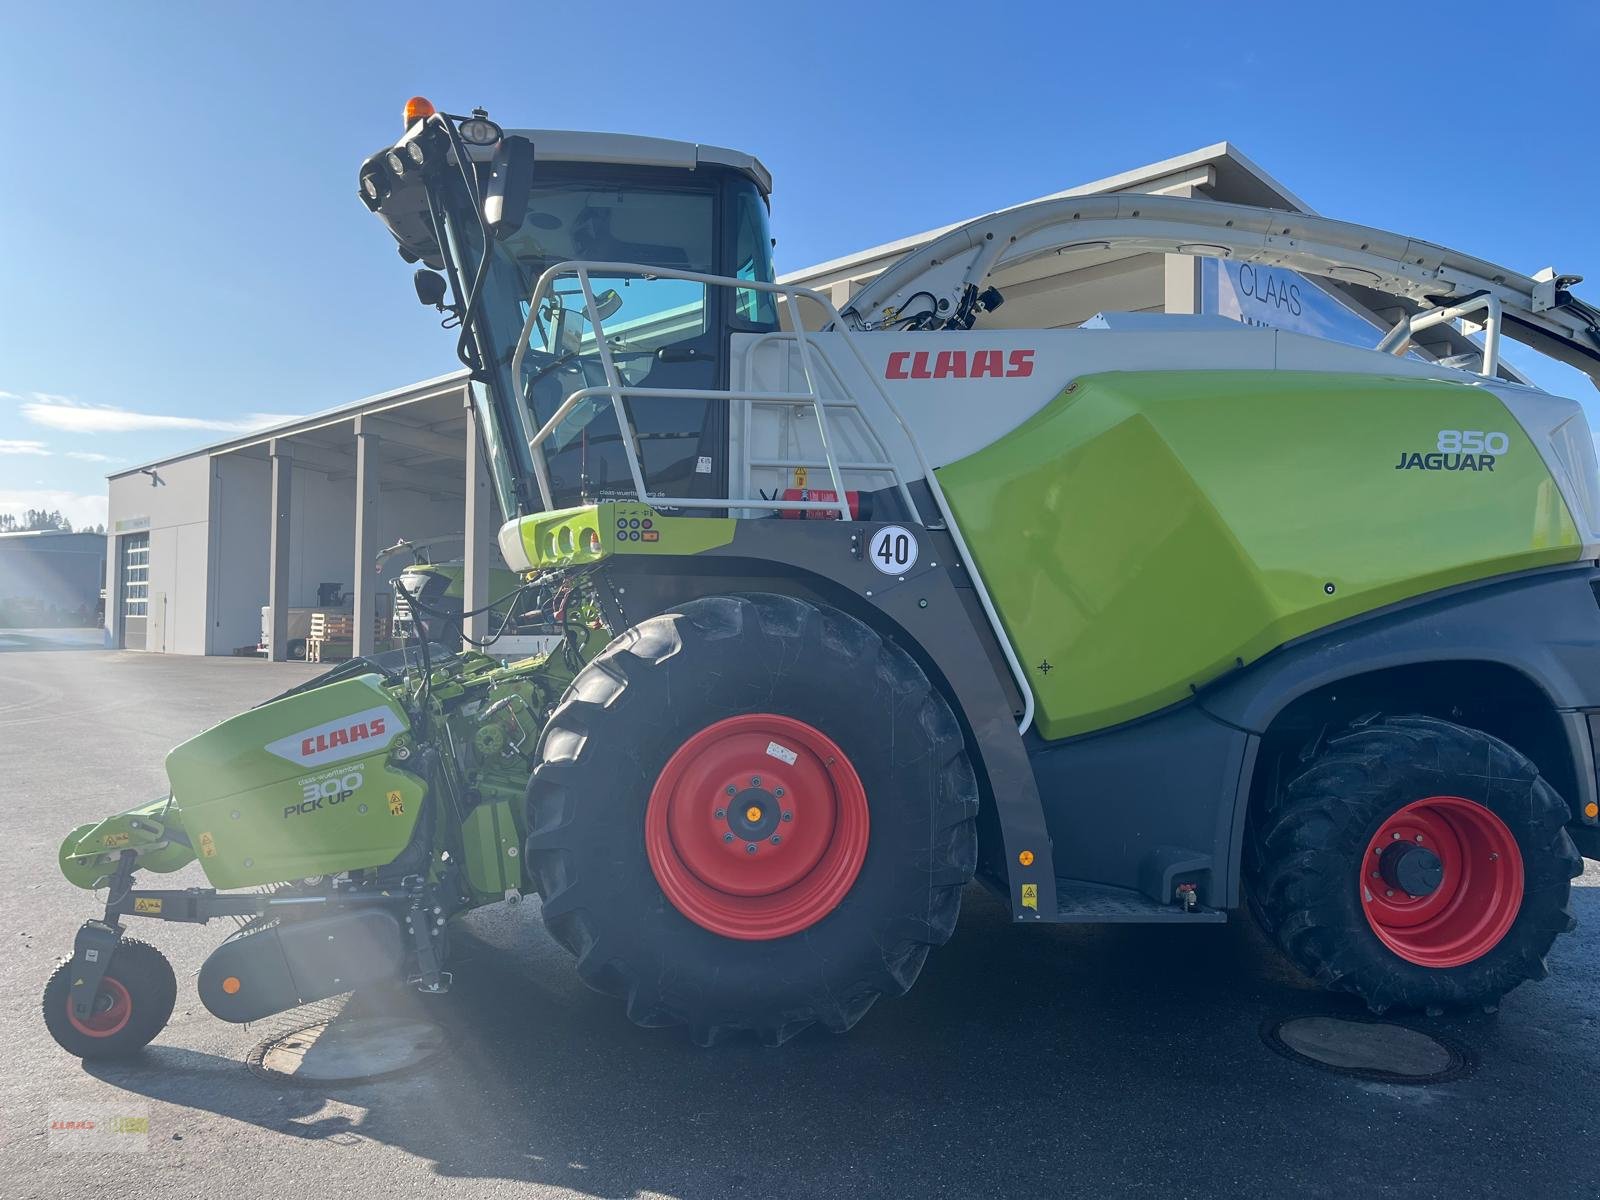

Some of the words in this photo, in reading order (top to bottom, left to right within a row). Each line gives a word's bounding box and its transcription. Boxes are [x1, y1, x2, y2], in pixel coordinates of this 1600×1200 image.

[1239, 263, 1302, 317] CLAAS
[885, 350, 1035, 379] CLAAS
[1437, 430, 1509, 456] 850
[1395, 452, 1496, 472] JAGUAR
[877, 533, 909, 565] 40
[301, 717, 386, 757] CLAAS
[303, 772, 364, 803] 300
[283, 797, 324, 819] PICK
[328, 789, 354, 805] UP
